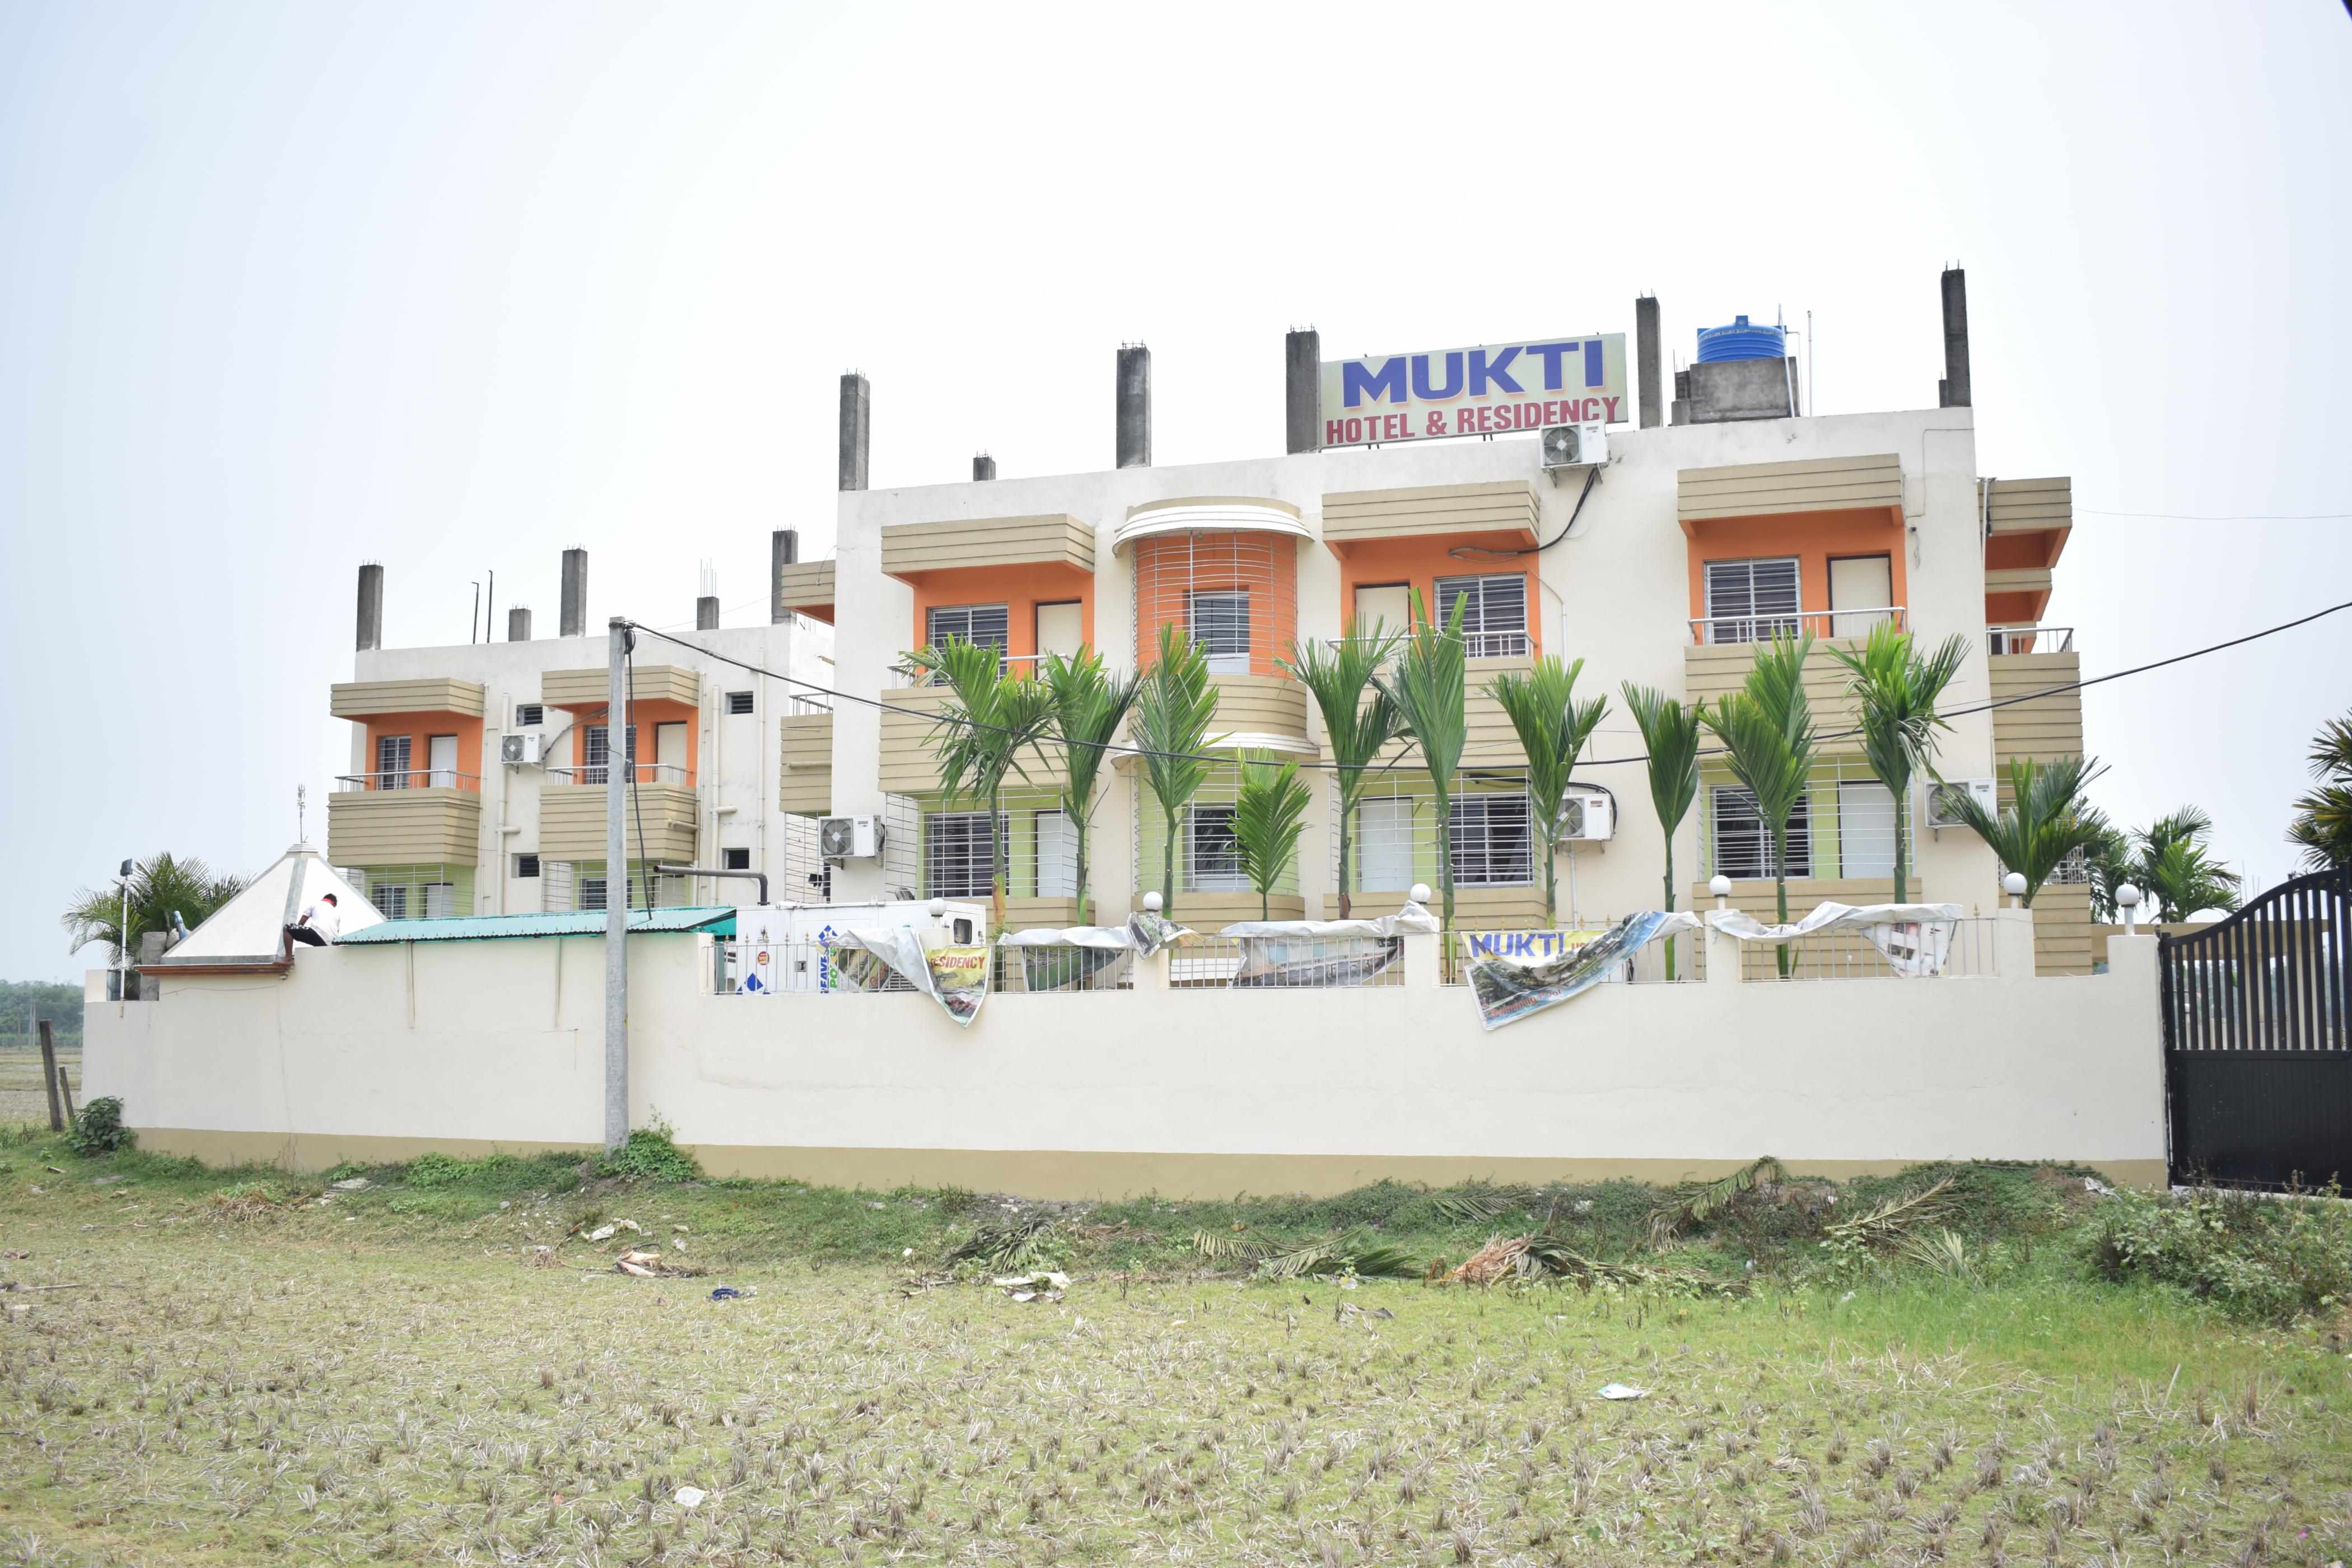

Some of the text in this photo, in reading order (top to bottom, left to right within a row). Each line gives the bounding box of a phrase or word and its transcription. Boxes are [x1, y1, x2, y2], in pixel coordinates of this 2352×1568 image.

[1342, 340, 1603, 408] MUKTI
[1326, 396, 1620, 445] HOTEL & RESIDENCY
[1469, 933, 1564, 957] MUKTI
[1490, 988, 1561, 1019] Swimming Pool
